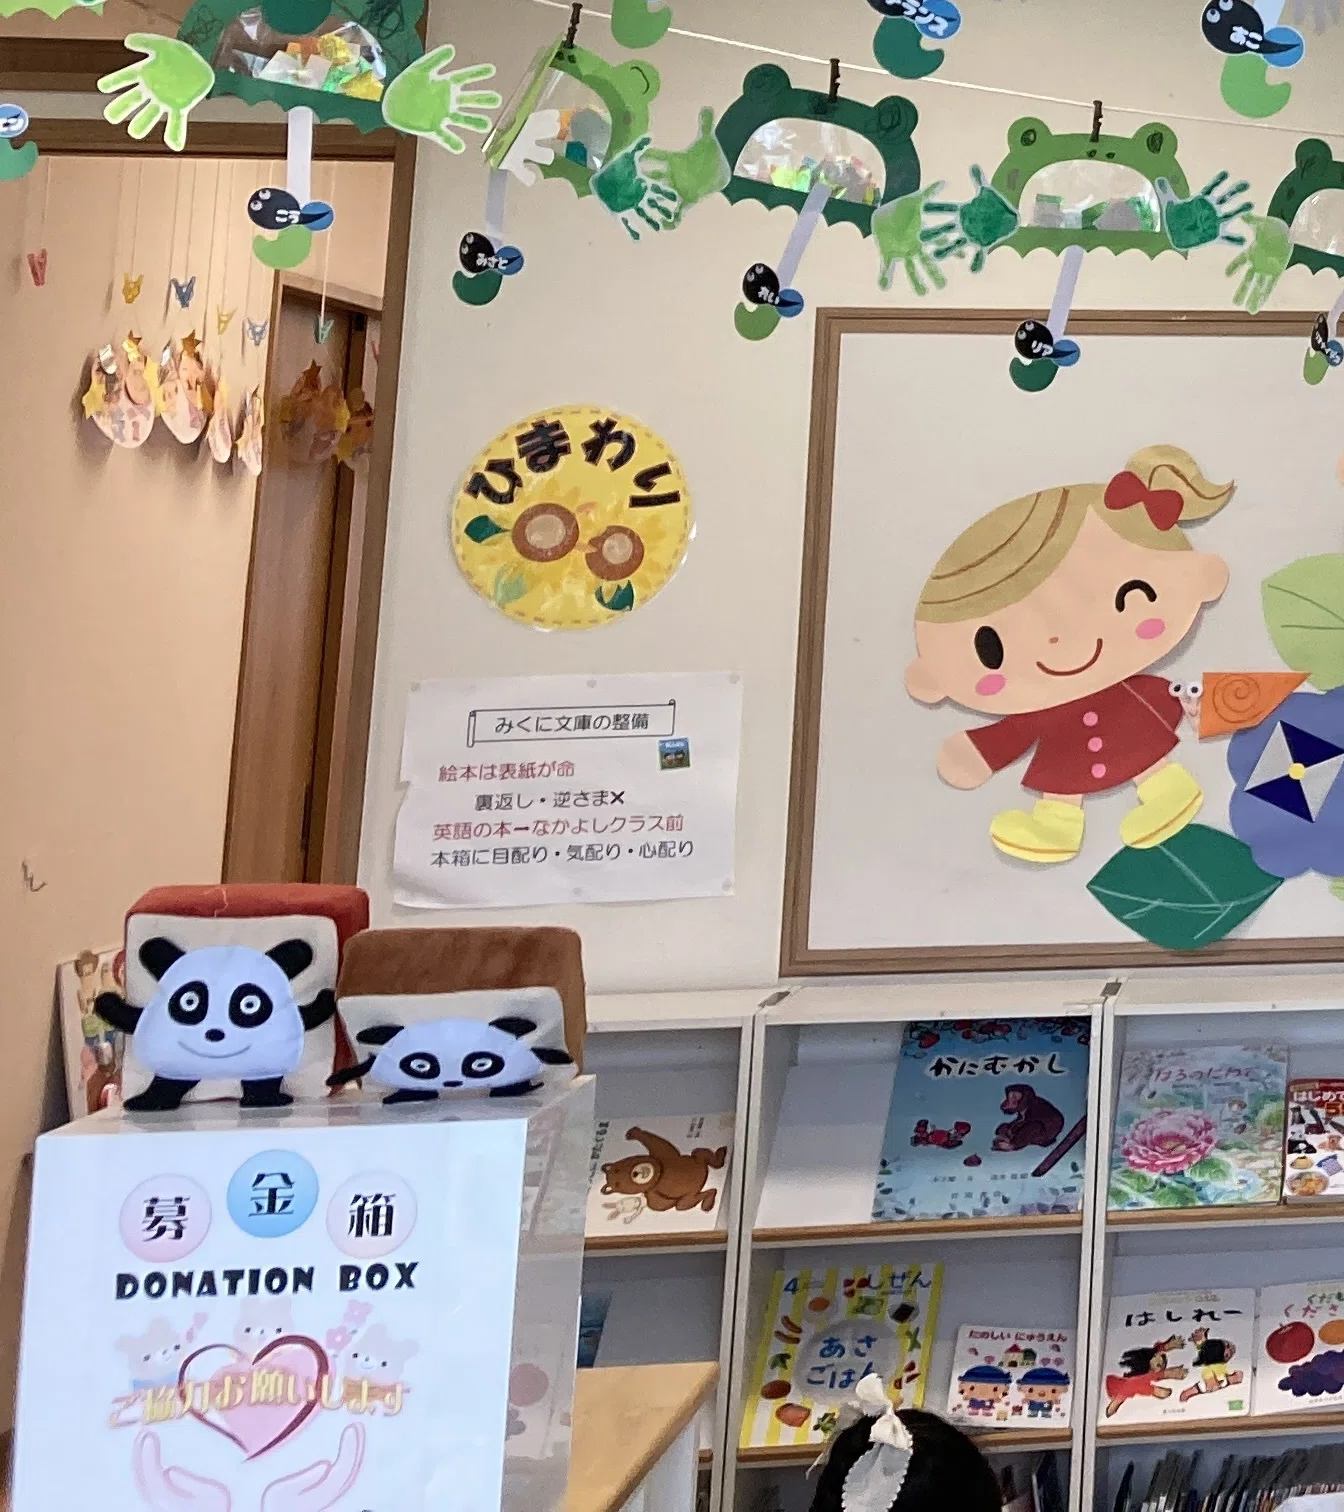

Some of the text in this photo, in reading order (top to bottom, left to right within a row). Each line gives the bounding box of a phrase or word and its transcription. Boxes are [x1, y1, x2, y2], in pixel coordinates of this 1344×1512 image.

[1229, 25, 1263, 51] あこ
[476, 252, 509, 270] みさと
[1031, 339, 1054, 356] リア
[466, 418, 683, 511] ひまわり
[494, 712, 650, 735] みくに文庫の整備
[437, 760, 576, 783] 絵本は表紙が命
[430, 838, 695, 868] 本箱に目配り・気配り・心配り
[141, 1170, 397, 1243] 募金箱
[114, 1261, 419, 1301] DONATION BOX
[782, 1276, 801, 1295] 4
[866, 1271, 933, 1295] しぜん
[1124, 1308, 1244, 1328] はしれー
[818, 1333, 878, 1360] あさ
[968, 1329, 1069, 1343] たのしい にゅうえん
[108, 1366, 412, 1429] ご協力お願いします
